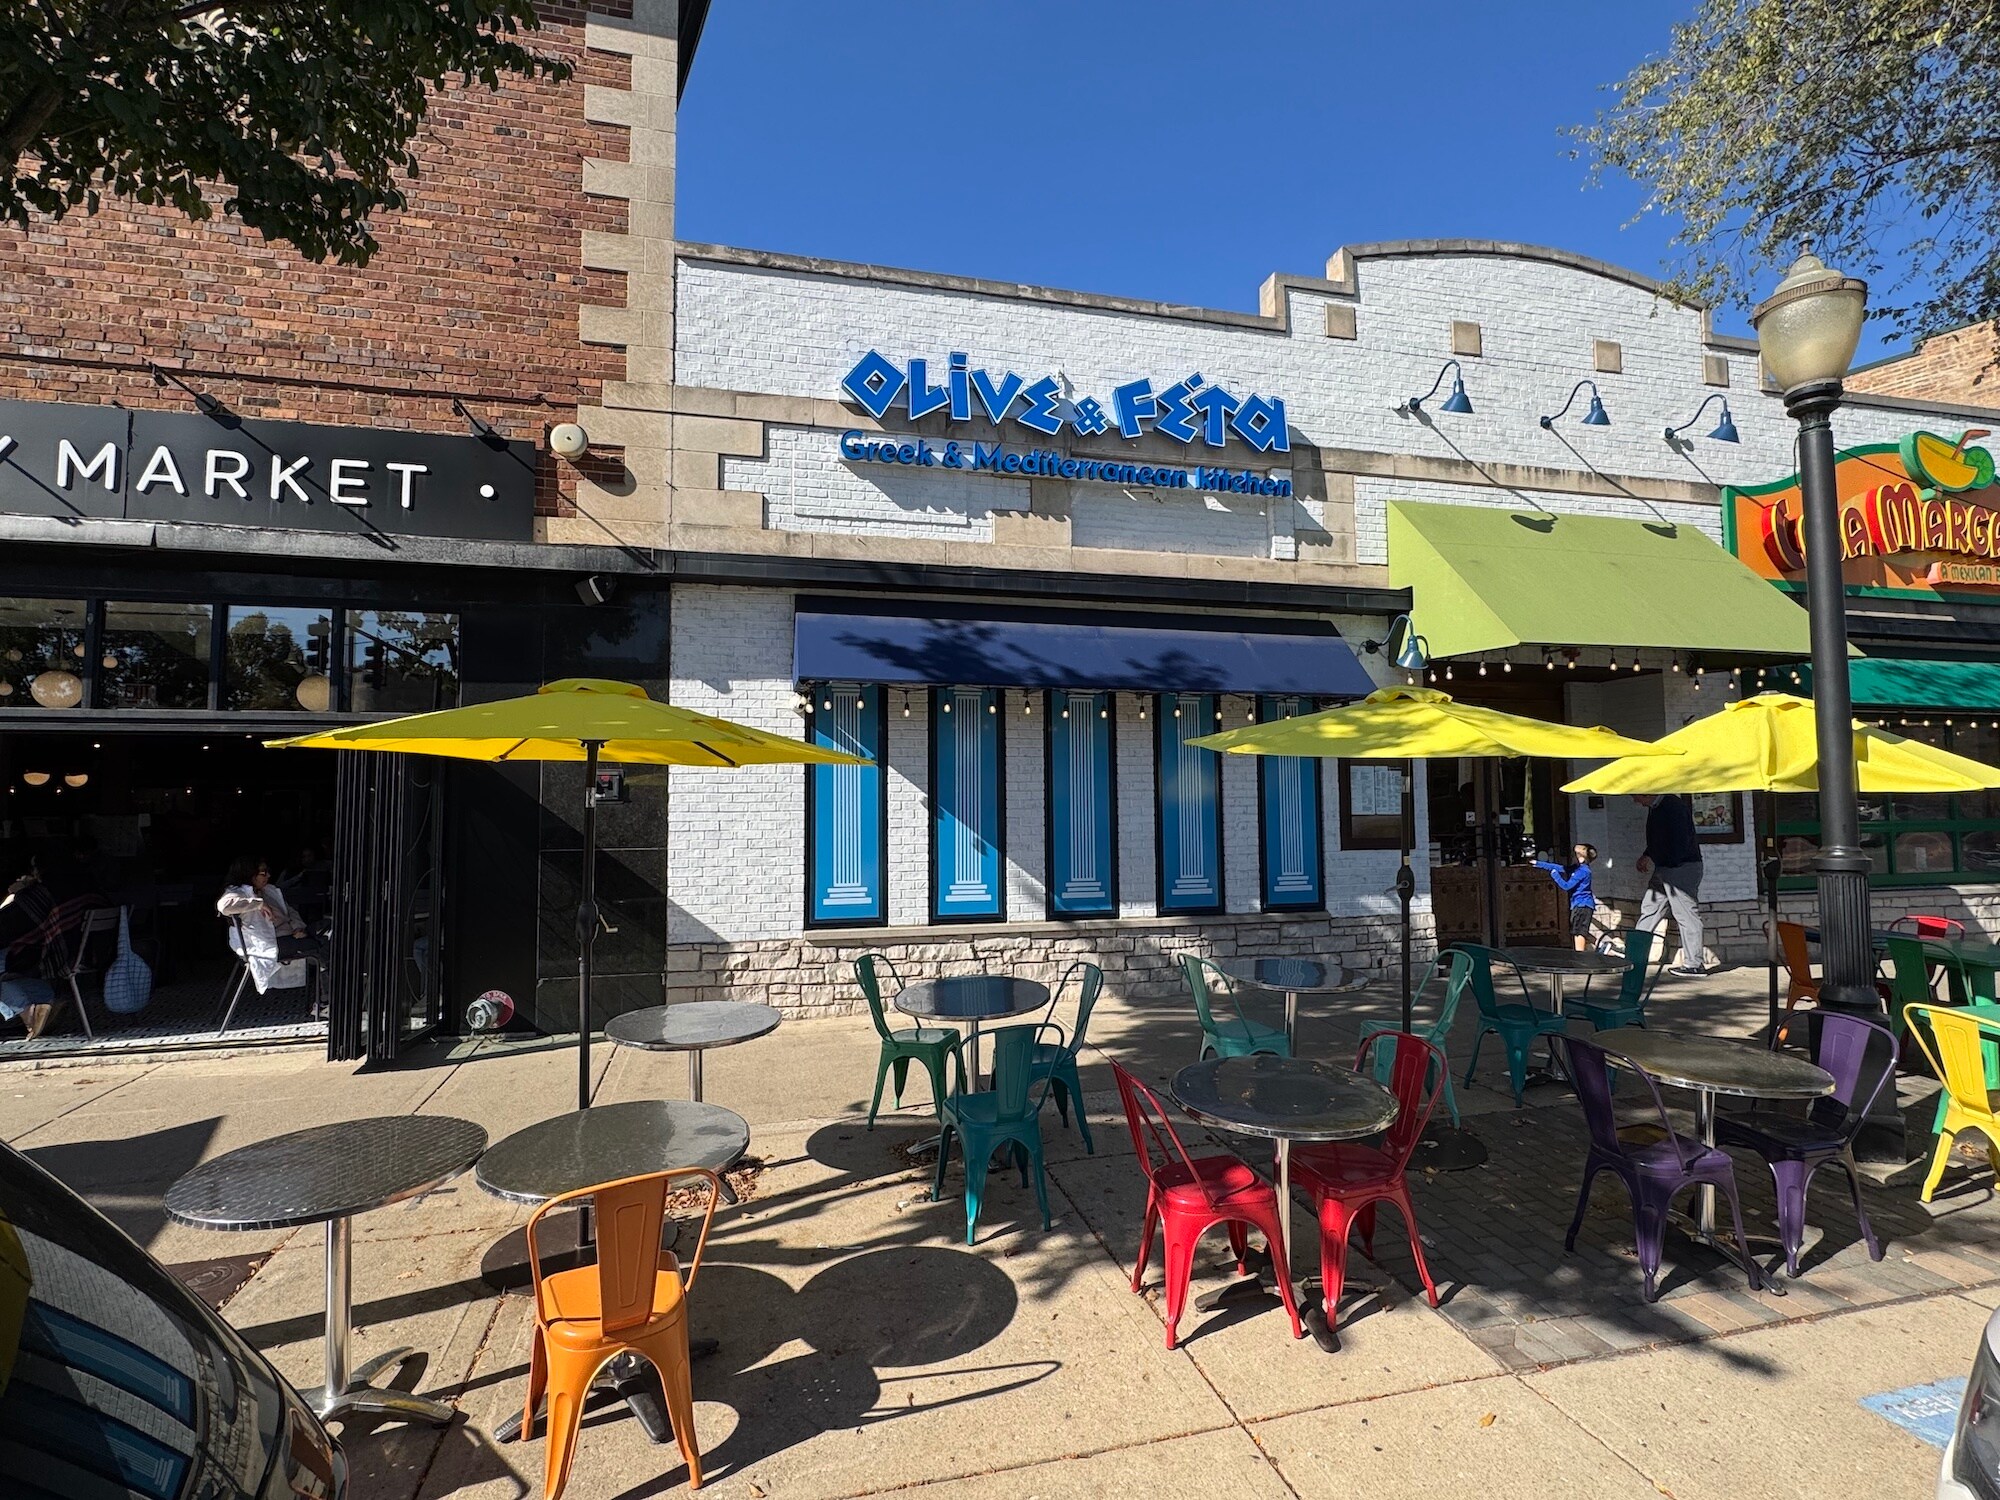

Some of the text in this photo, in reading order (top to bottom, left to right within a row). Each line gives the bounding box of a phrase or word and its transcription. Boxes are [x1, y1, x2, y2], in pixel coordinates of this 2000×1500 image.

[1073, 396, 1108, 437] &
[56, 438, 429, 509] MARKET
[841, 429, 933, 467] Greek
[942, 441, 963, 468] &
[972, 441, 1188, 488] Mediterranean
[1951, 565, 1992, 581] MEXICAN
